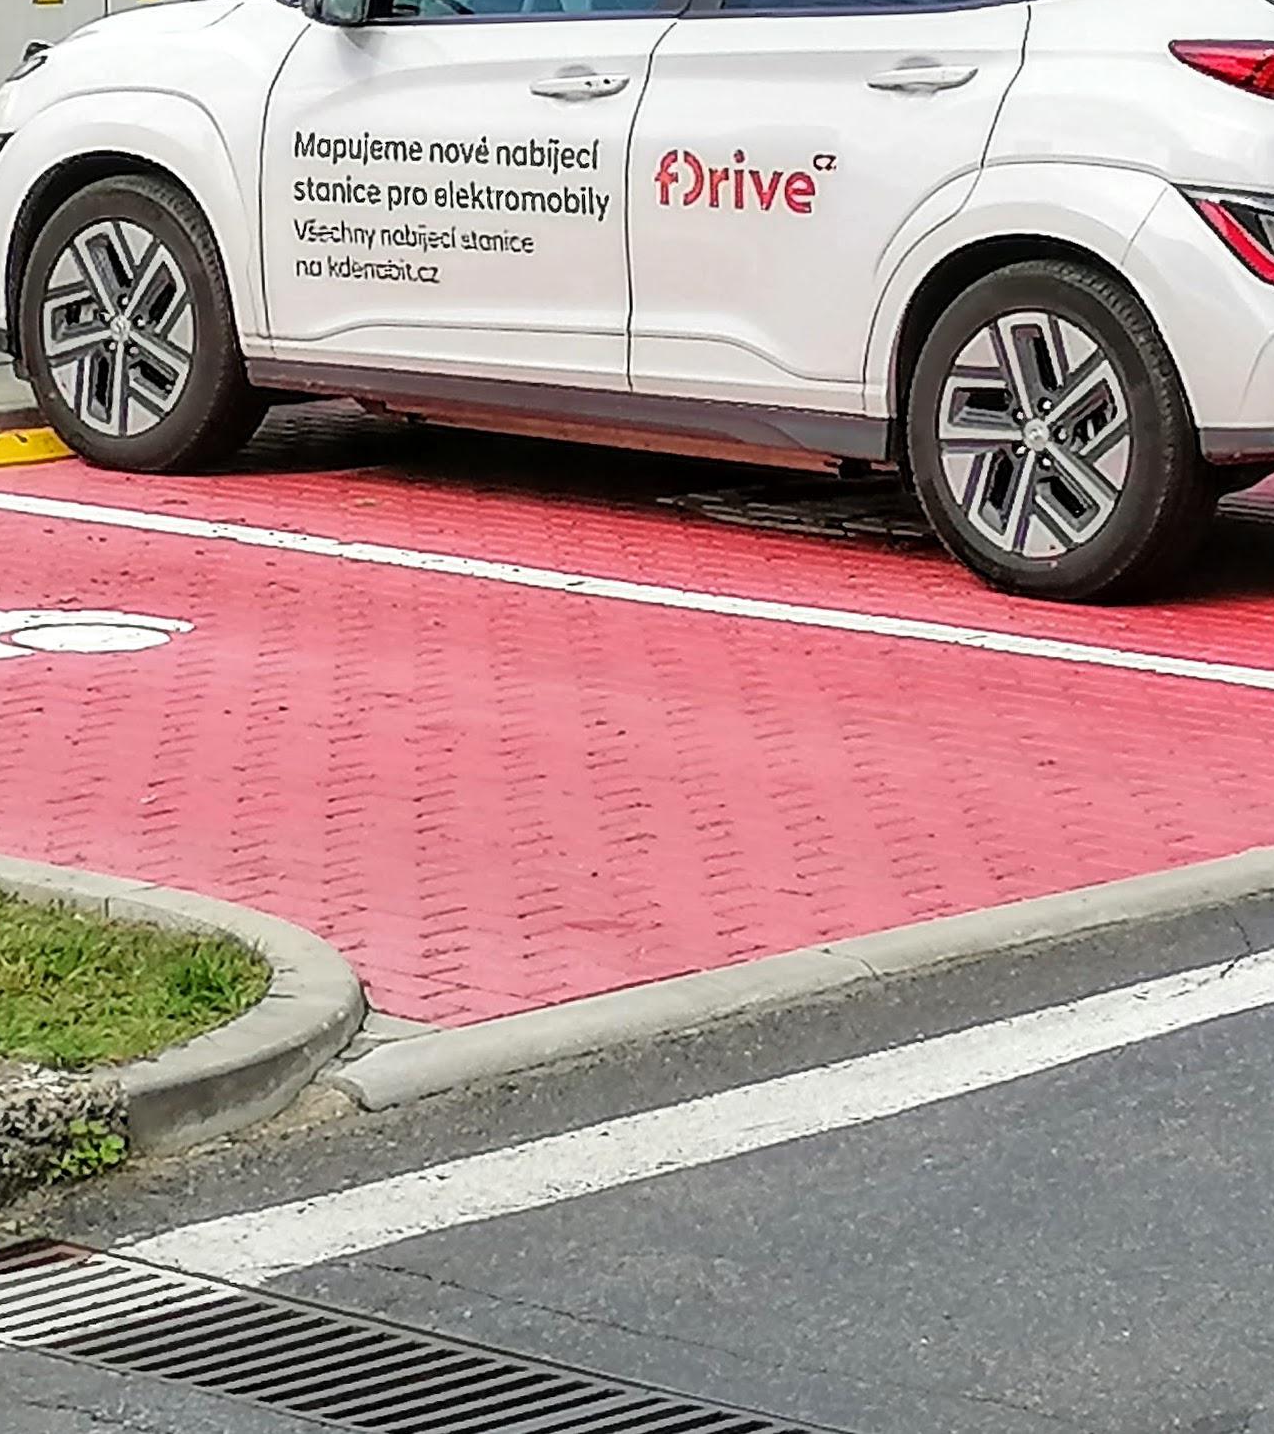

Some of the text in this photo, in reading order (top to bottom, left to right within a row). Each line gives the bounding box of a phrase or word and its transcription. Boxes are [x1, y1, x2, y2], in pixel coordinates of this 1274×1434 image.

[294, 132, 600, 174] Mapujeme nové nabíjecí
[294, 176, 610, 222] stanice pro elektromobily
[294, 219, 535, 254] Všechny nabíjecí stanice
[296, 259, 322, 278] na
